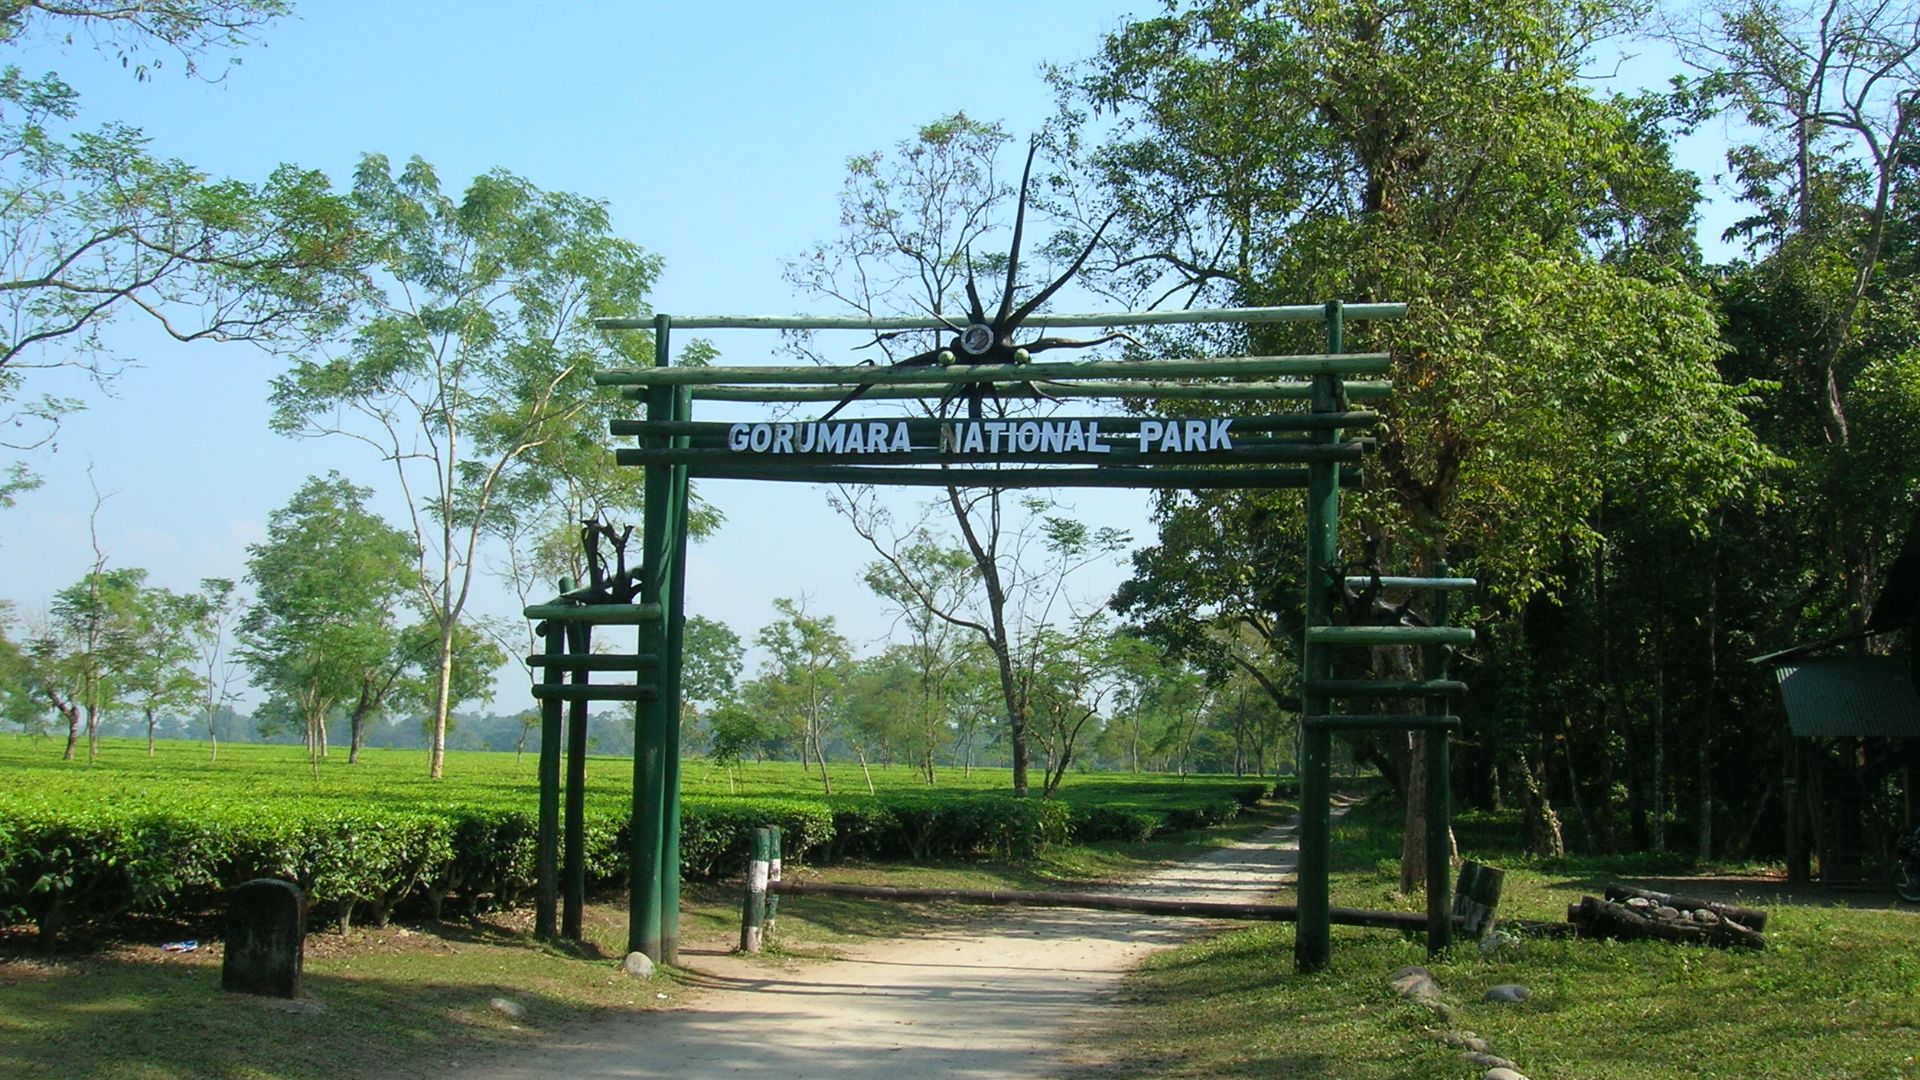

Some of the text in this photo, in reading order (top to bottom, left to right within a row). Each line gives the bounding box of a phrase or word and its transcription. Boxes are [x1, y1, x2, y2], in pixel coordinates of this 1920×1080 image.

[729, 419, 1233, 454] GORUMARA NATIONAL PARK
